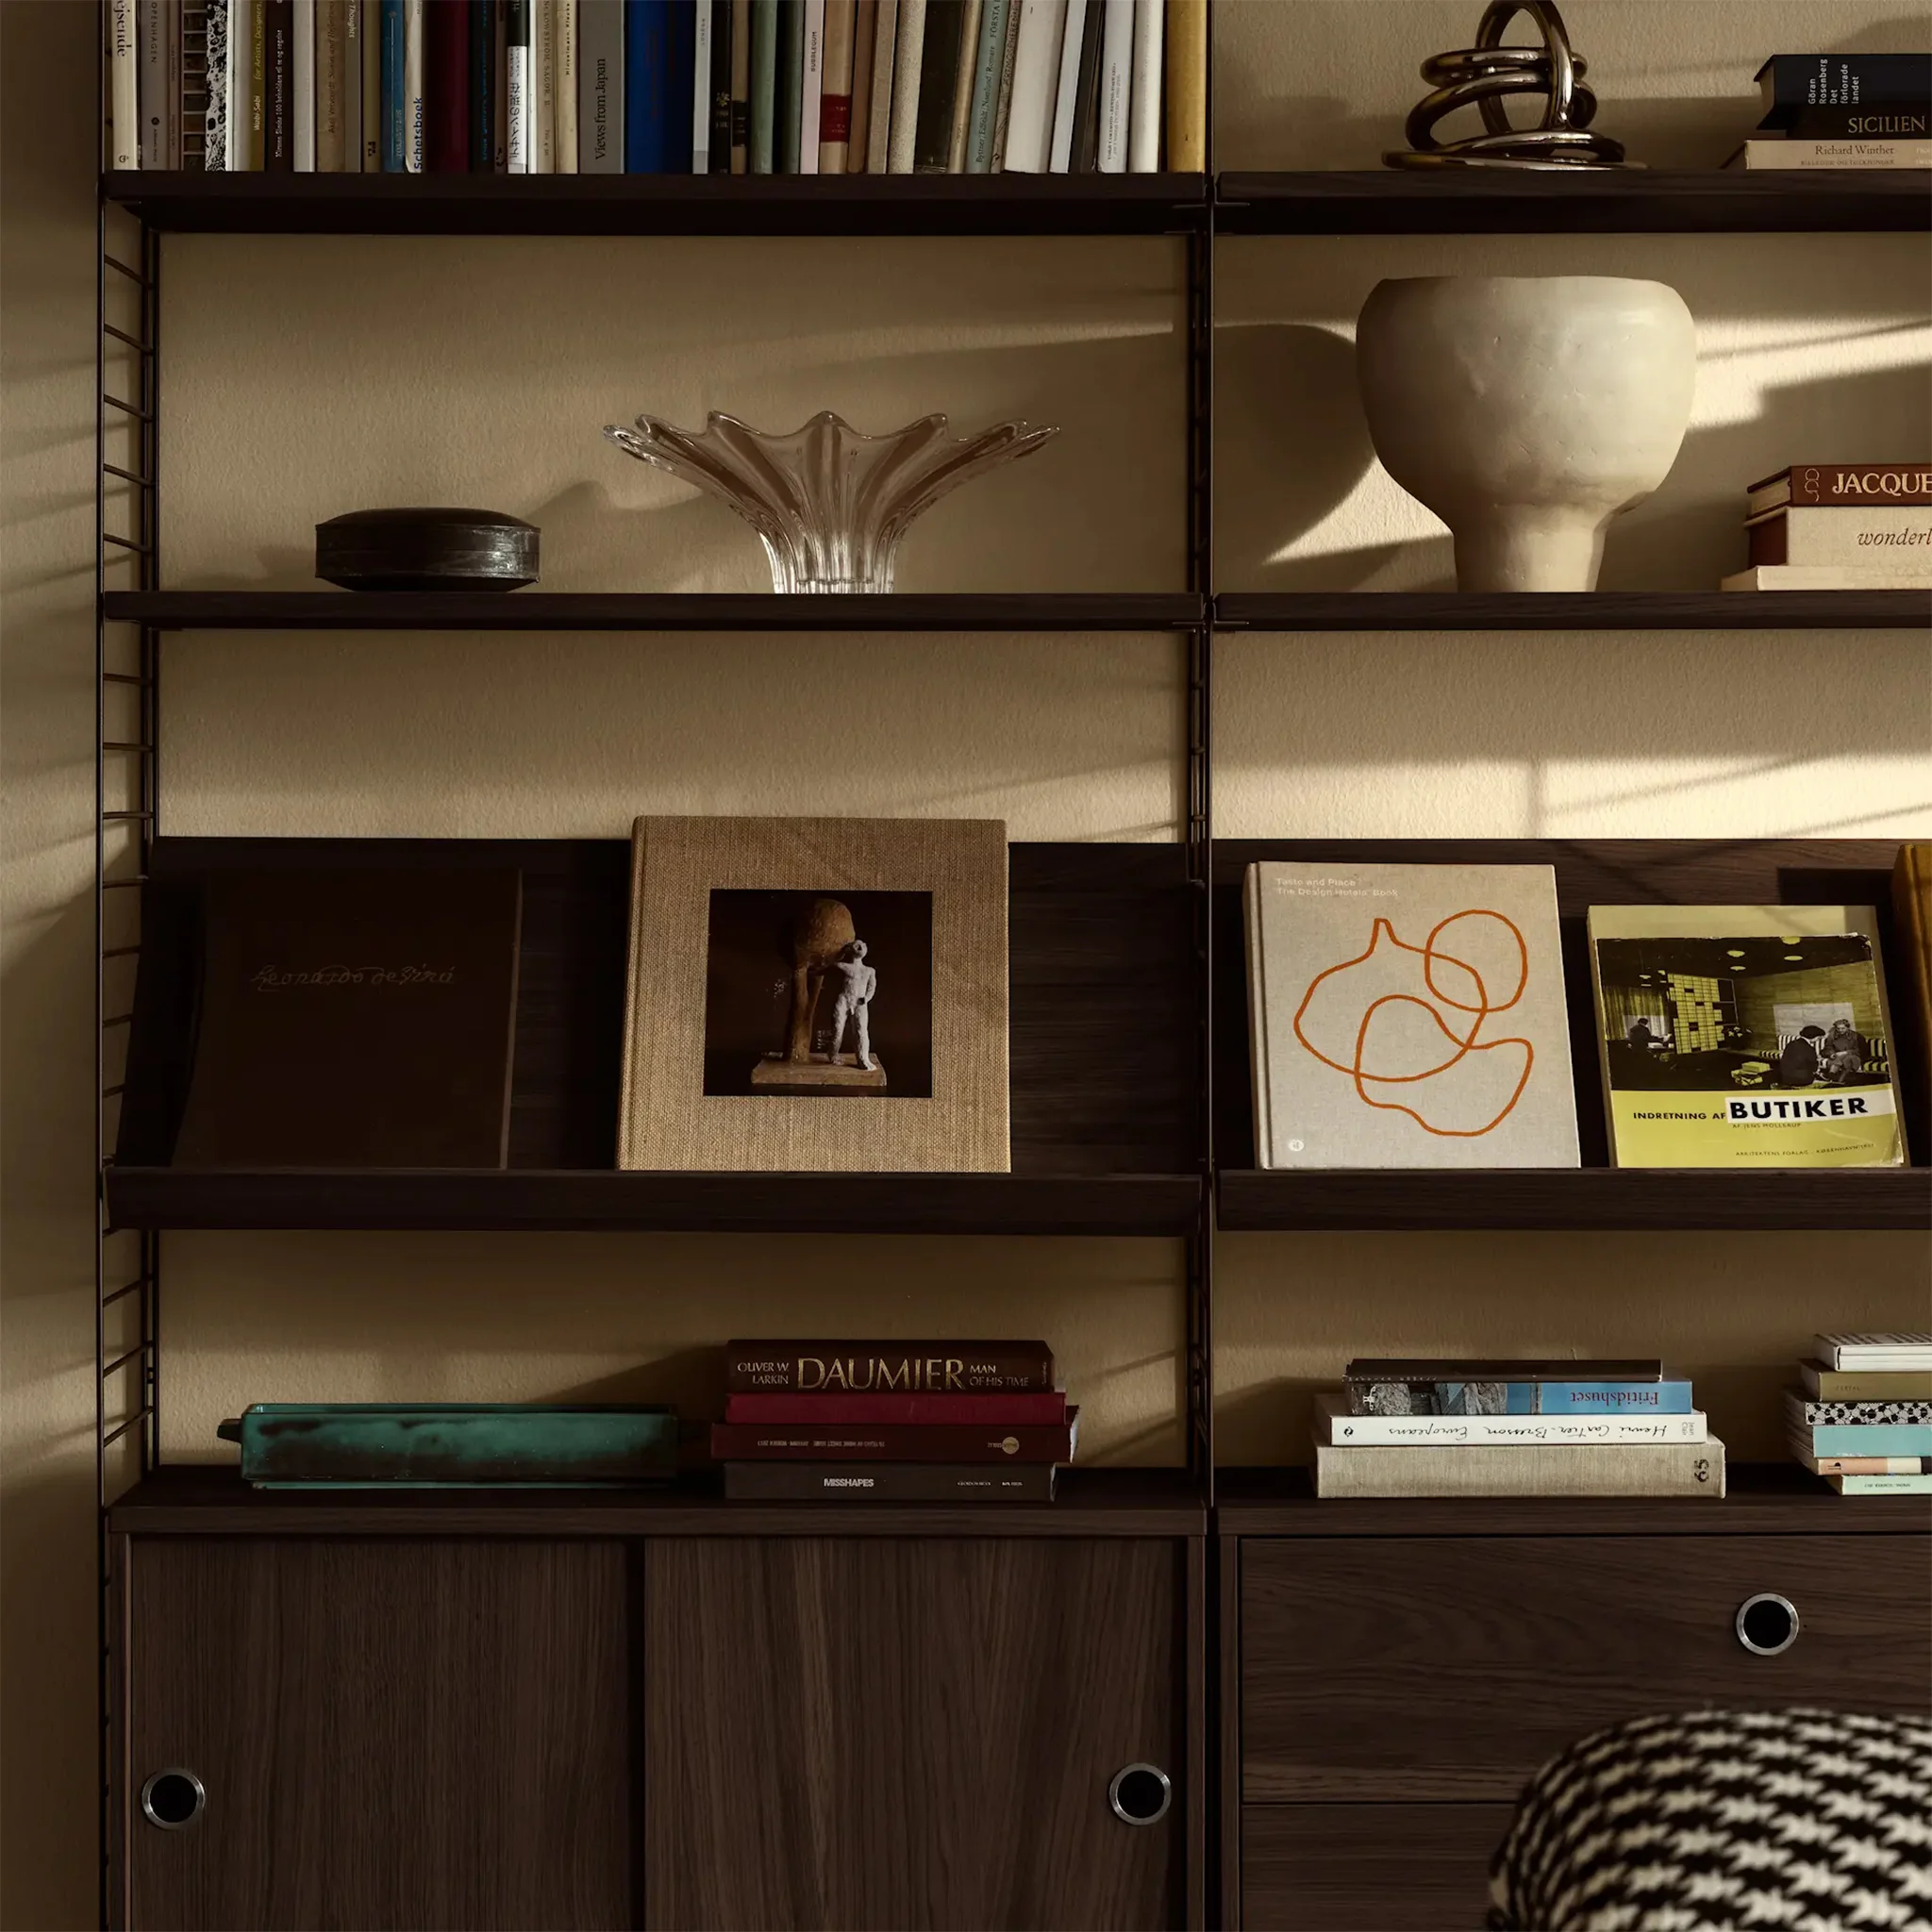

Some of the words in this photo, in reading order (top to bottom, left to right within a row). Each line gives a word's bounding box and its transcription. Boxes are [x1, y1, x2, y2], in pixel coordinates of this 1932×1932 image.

[347, 4, 357, 39] Thoughts
[595, 58, 608, 93] Japan
[1819, 58, 1828, 105] Rosenberg
[1840, 63, 1849, 105] förlorade
[1807, 78, 1817, 105] Göran
[1829, 89, 1839, 105] Det
[1851, 75, 1859, 105] landet
[593, 95, 606, 124] from
[413, 97, 423, 170] Schetsboek
[1847, 114, 1926, 134] SICILIEN
[594, 125, 606, 160] Views
[1815, 144, 1853, 156] Richard
[1855, 144, 1894, 156] Winther
[1831, 473, 1932, 497] JACQUE
[1275, 877, 1304, 886] Taste
[1327, 878, 1357, 887] Place
[1277, 887, 1296, 895] The
[1298, 888, 1333, 897] Design
[1373, 889, 1398, 897] Book
[1633, 1111, 1707, 1121] INDRETNING
[1711, 1111, 1727, 1121] AF
[1728, 1096, 1869, 1120] BUTIKER
[737, 1361, 774, 1373] OLIVER
[776, 1361, 790, 1373] W.
[797, 1357, 967, 1391] DAUMIER
[969, 1364, 997, 1374] MAN
[752, 1374, 790, 1385] LARKIN
[969, 1376, 984, 1387] OF
[985, 1376, 1004, 1387] HIS
[1005, 1376, 1030, 1387] TIME
[1570, 1391, 1659, 1407] Fritidshuset
[1389, 1423, 1468, 1441] Europeans
[1619, 1424, 1668, 1439] Henri
[1693, 1458, 1709, 1483] 65
[823, 1477, 874, 1488] MISSHAPES
